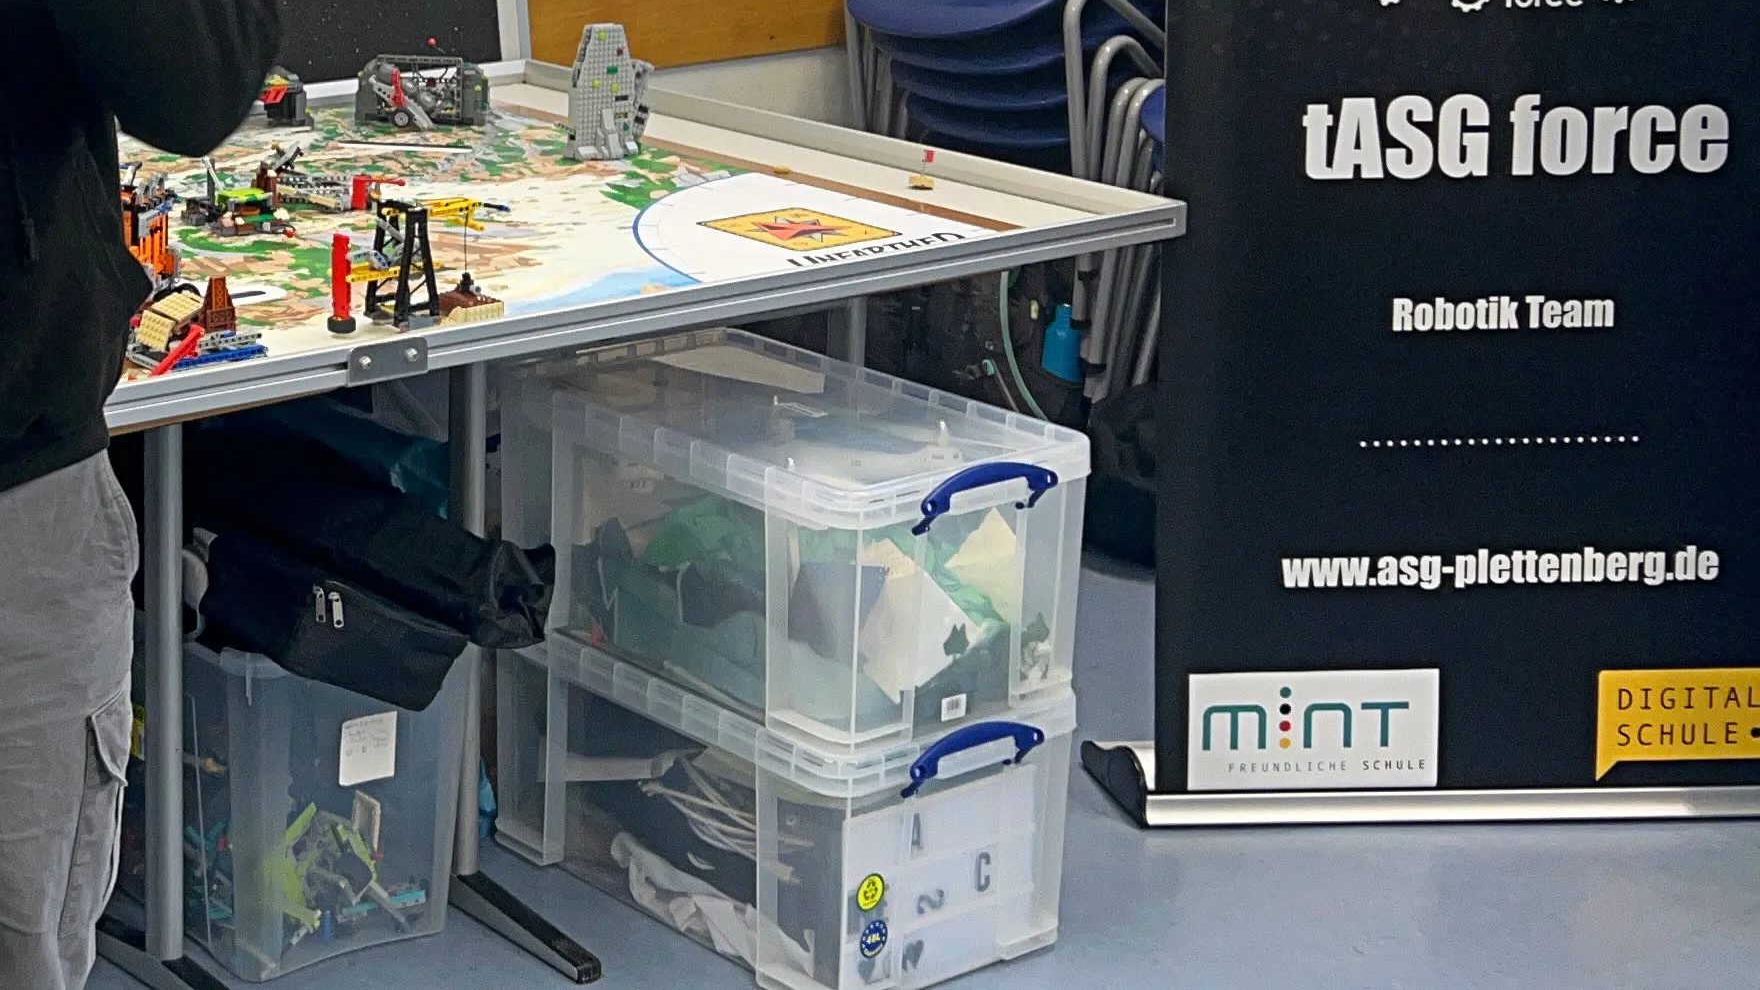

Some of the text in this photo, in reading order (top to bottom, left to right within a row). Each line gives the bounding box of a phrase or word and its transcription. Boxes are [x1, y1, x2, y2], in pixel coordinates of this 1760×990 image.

[1302, 93, 1730, 181] tASG force
[1392, 294, 1615, 332] Robotik Team
[1281, 545, 1721, 591] www.asg-plettenberg.de
[1617, 686, 1760, 711] DIGITAL
[1617, 721, 1739, 747] SCHULE
[1228, 758, 1427, 774] FREUNDLICHE SCHULE
